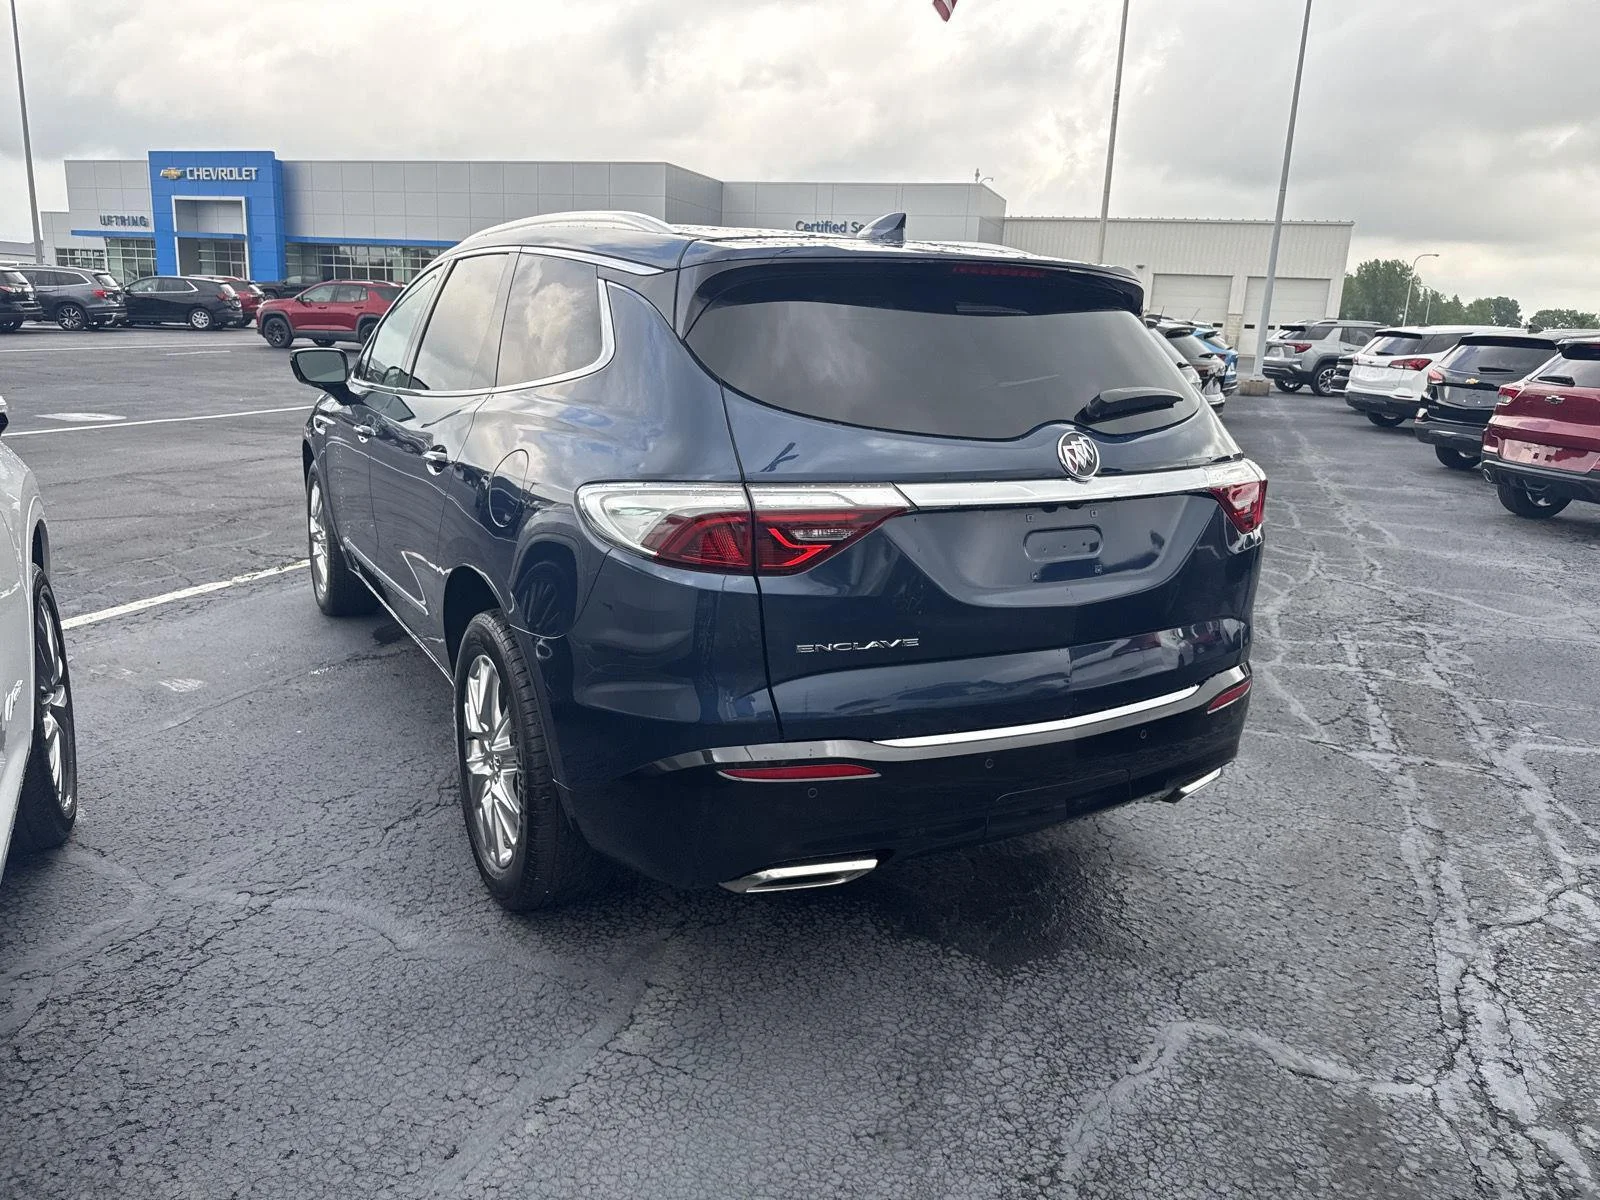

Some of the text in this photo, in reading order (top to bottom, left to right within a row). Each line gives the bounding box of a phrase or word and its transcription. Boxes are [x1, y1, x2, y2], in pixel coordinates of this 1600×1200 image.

[186, 167, 258, 181] CHEVROLET
[795, 220, 847, 234] Certified
[796, 638, 919, 653] ENCLAVE
